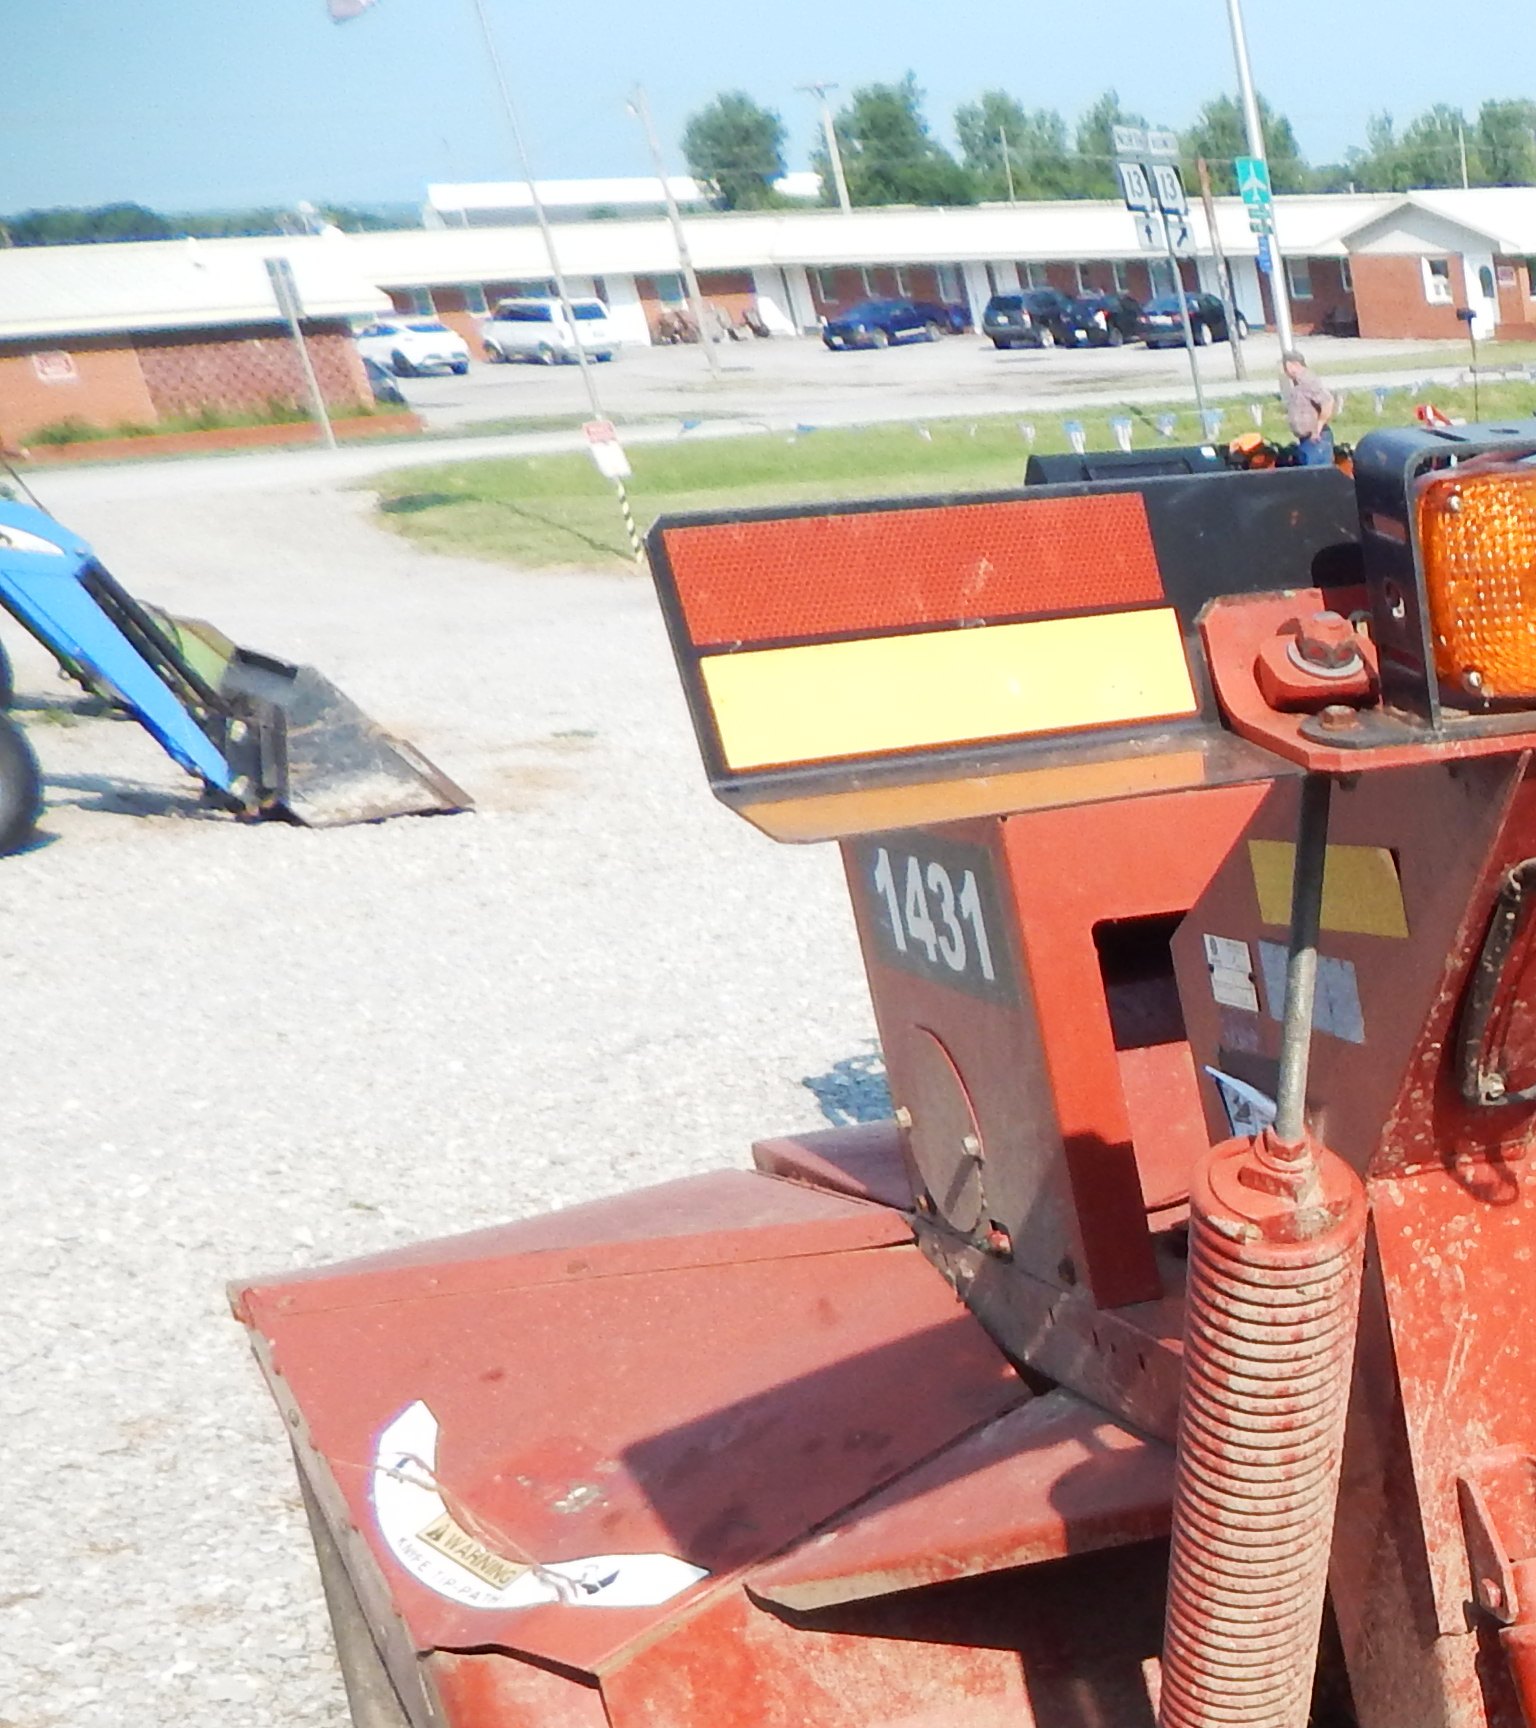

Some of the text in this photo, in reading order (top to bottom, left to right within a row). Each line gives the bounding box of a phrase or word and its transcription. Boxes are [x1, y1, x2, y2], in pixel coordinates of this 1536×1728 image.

[1128, 171, 1144, 198] 13
[1161, 173, 1177, 200] 13
[874, 847, 995, 981] 1431
[444, 1532, 517, 1584] WARNING
